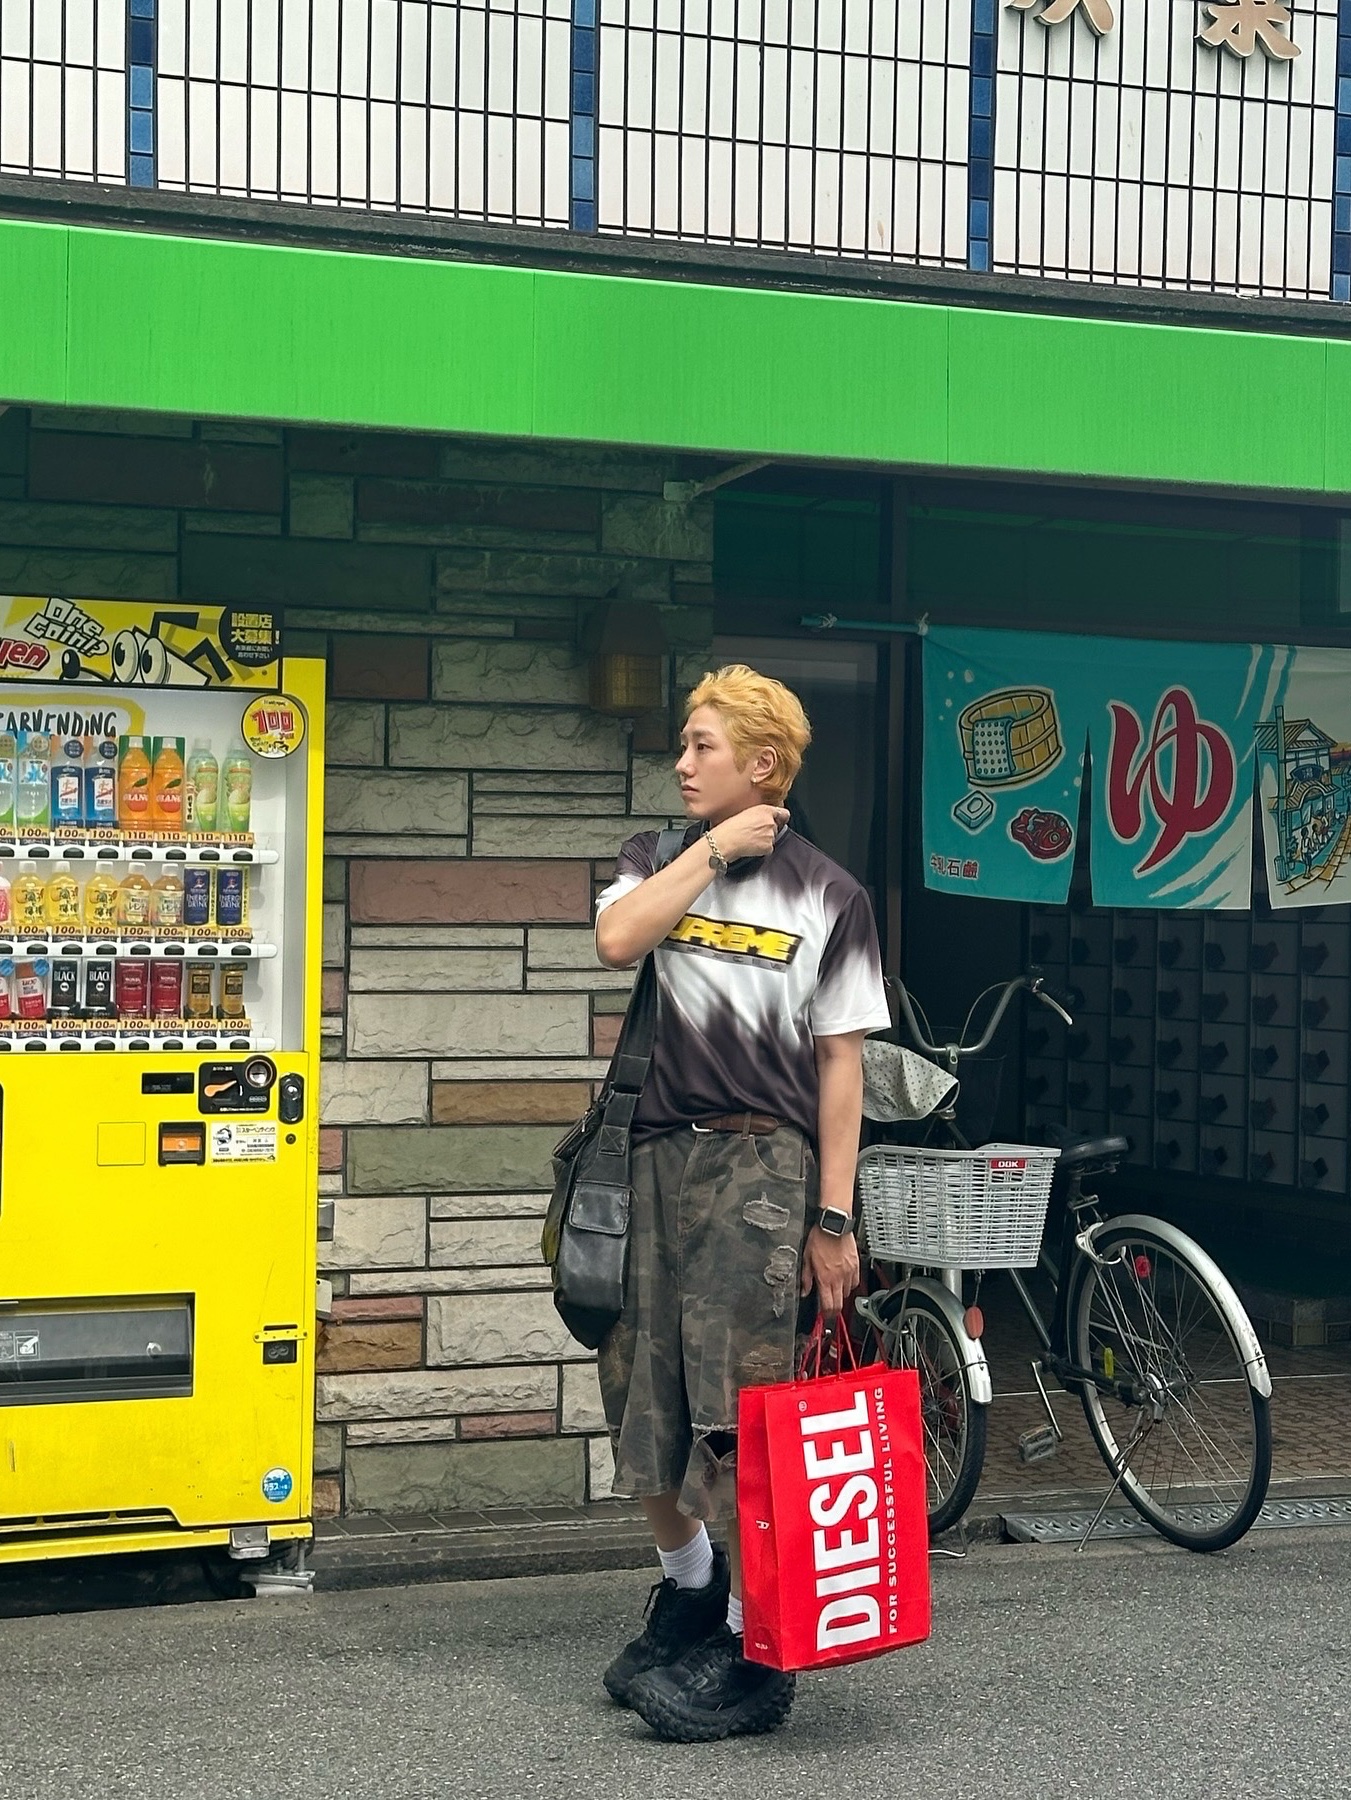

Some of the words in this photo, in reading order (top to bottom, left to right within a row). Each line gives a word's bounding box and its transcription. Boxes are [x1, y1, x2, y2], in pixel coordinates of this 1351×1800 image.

[251, 710, 294, 734] 100
[1105, 684, 1237, 879] ゆ
[874, 1387, 891, 1453] LIVING
[800, 1390, 881, 1652] DIESEL
[882, 1458, 898, 1587] SUCCESSFUL
[888, 1594, 898, 1635] FOR
